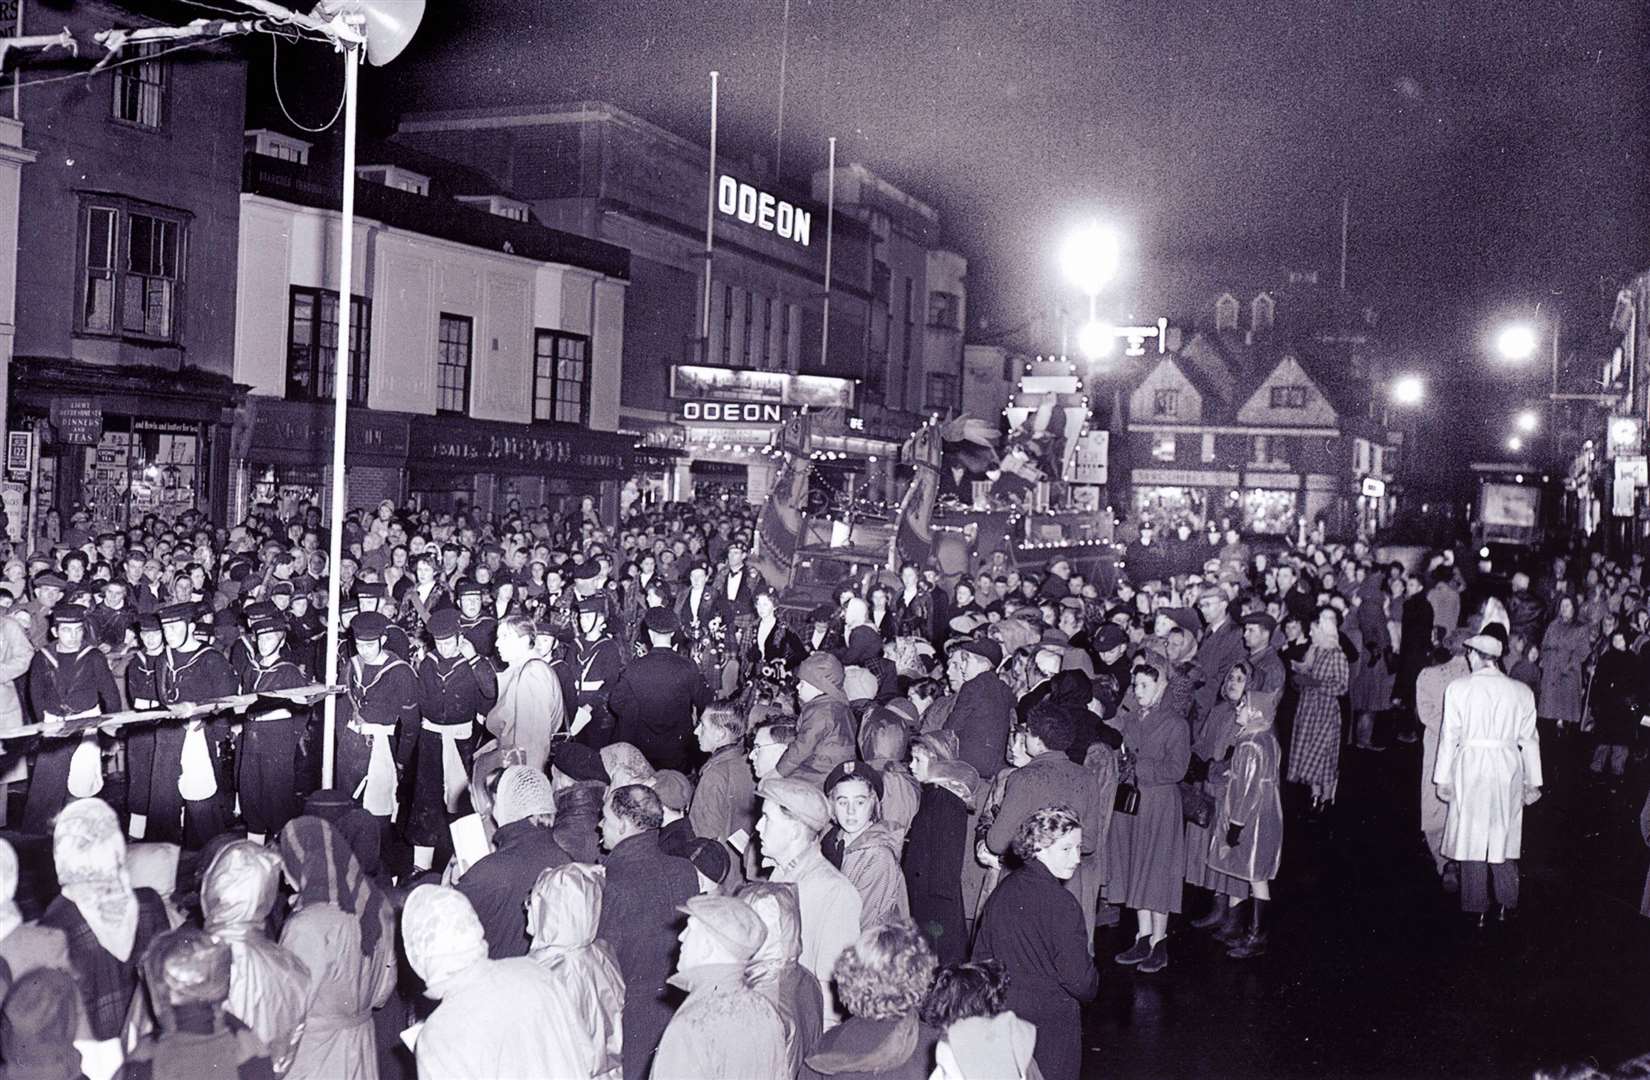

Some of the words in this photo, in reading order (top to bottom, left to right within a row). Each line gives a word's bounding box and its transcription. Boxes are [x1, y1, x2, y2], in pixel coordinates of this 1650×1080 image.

[718, 175, 811, 246] ODEON
[683, 402, 780, 422] ODEON
[62, 418, 100, 426] DINNERS
[69, 433, 93, 441] TEAS
